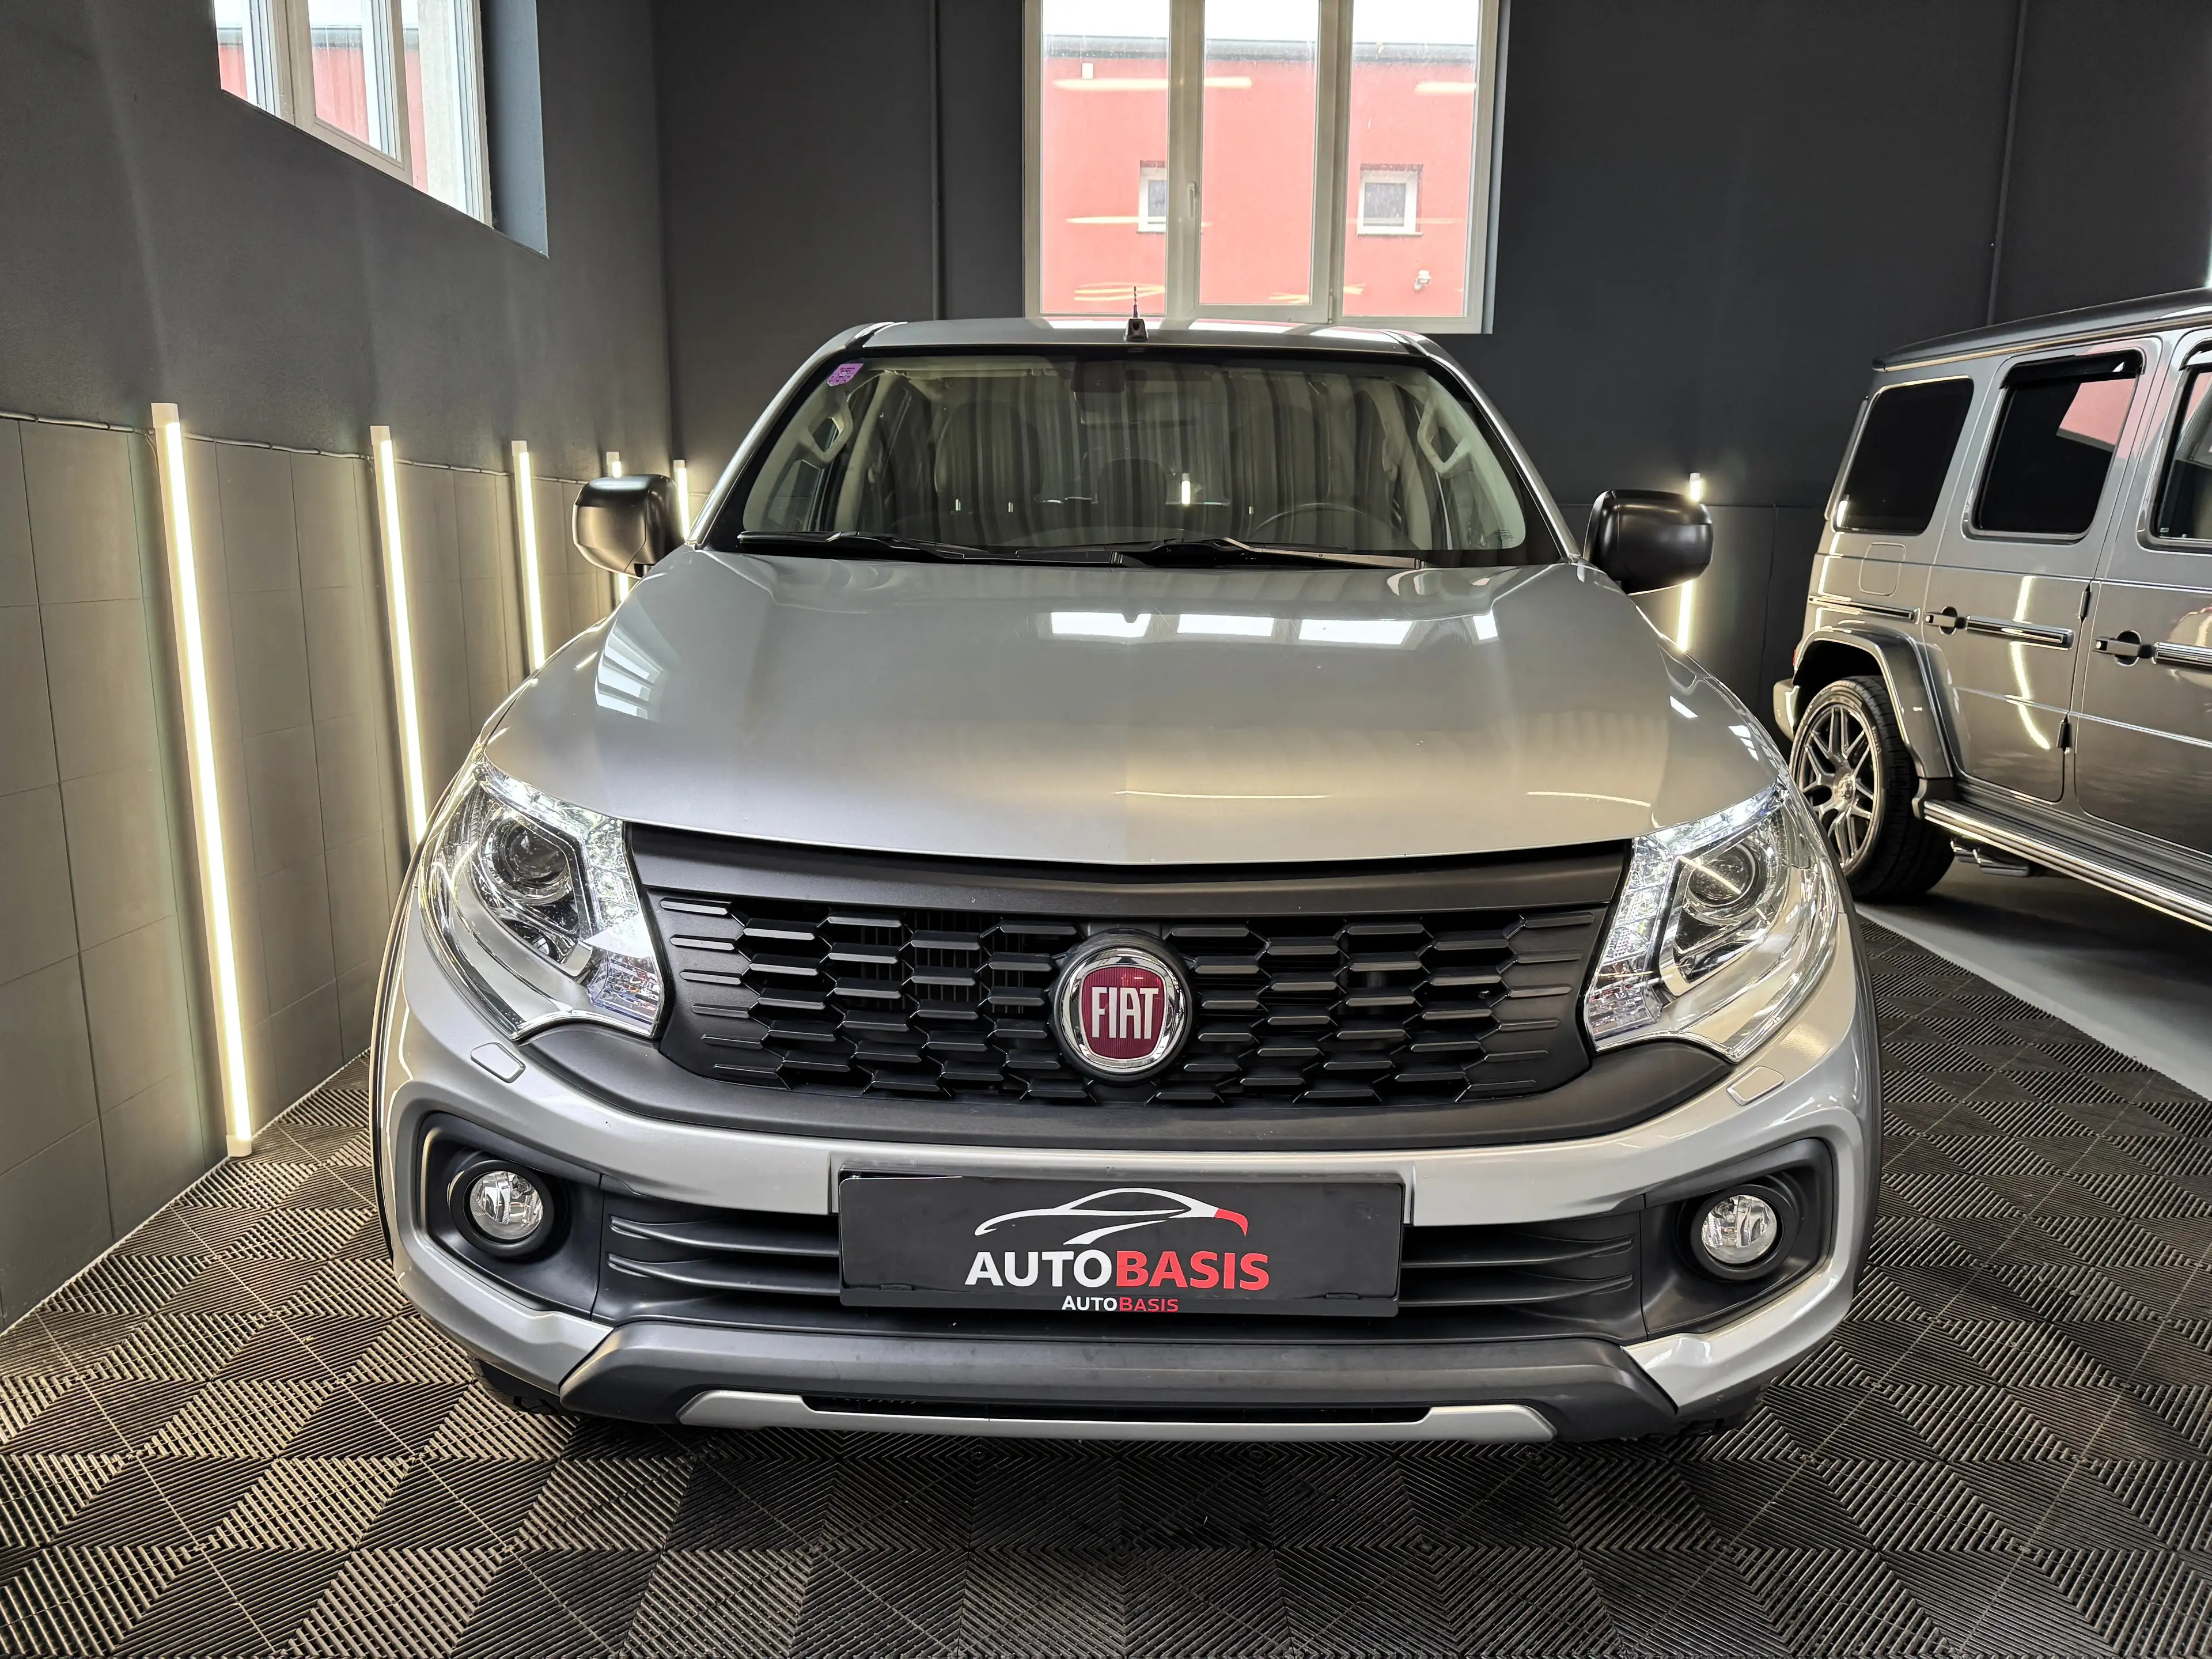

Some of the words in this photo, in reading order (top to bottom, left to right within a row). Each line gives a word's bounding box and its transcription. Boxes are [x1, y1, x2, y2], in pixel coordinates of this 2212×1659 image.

[1092, 986, 1159, 1039] FIAT
[965, 1249, 1269, 1290] AUTOBASIS
[1062, 1296, 1179, 1312] AUTOBASIS
